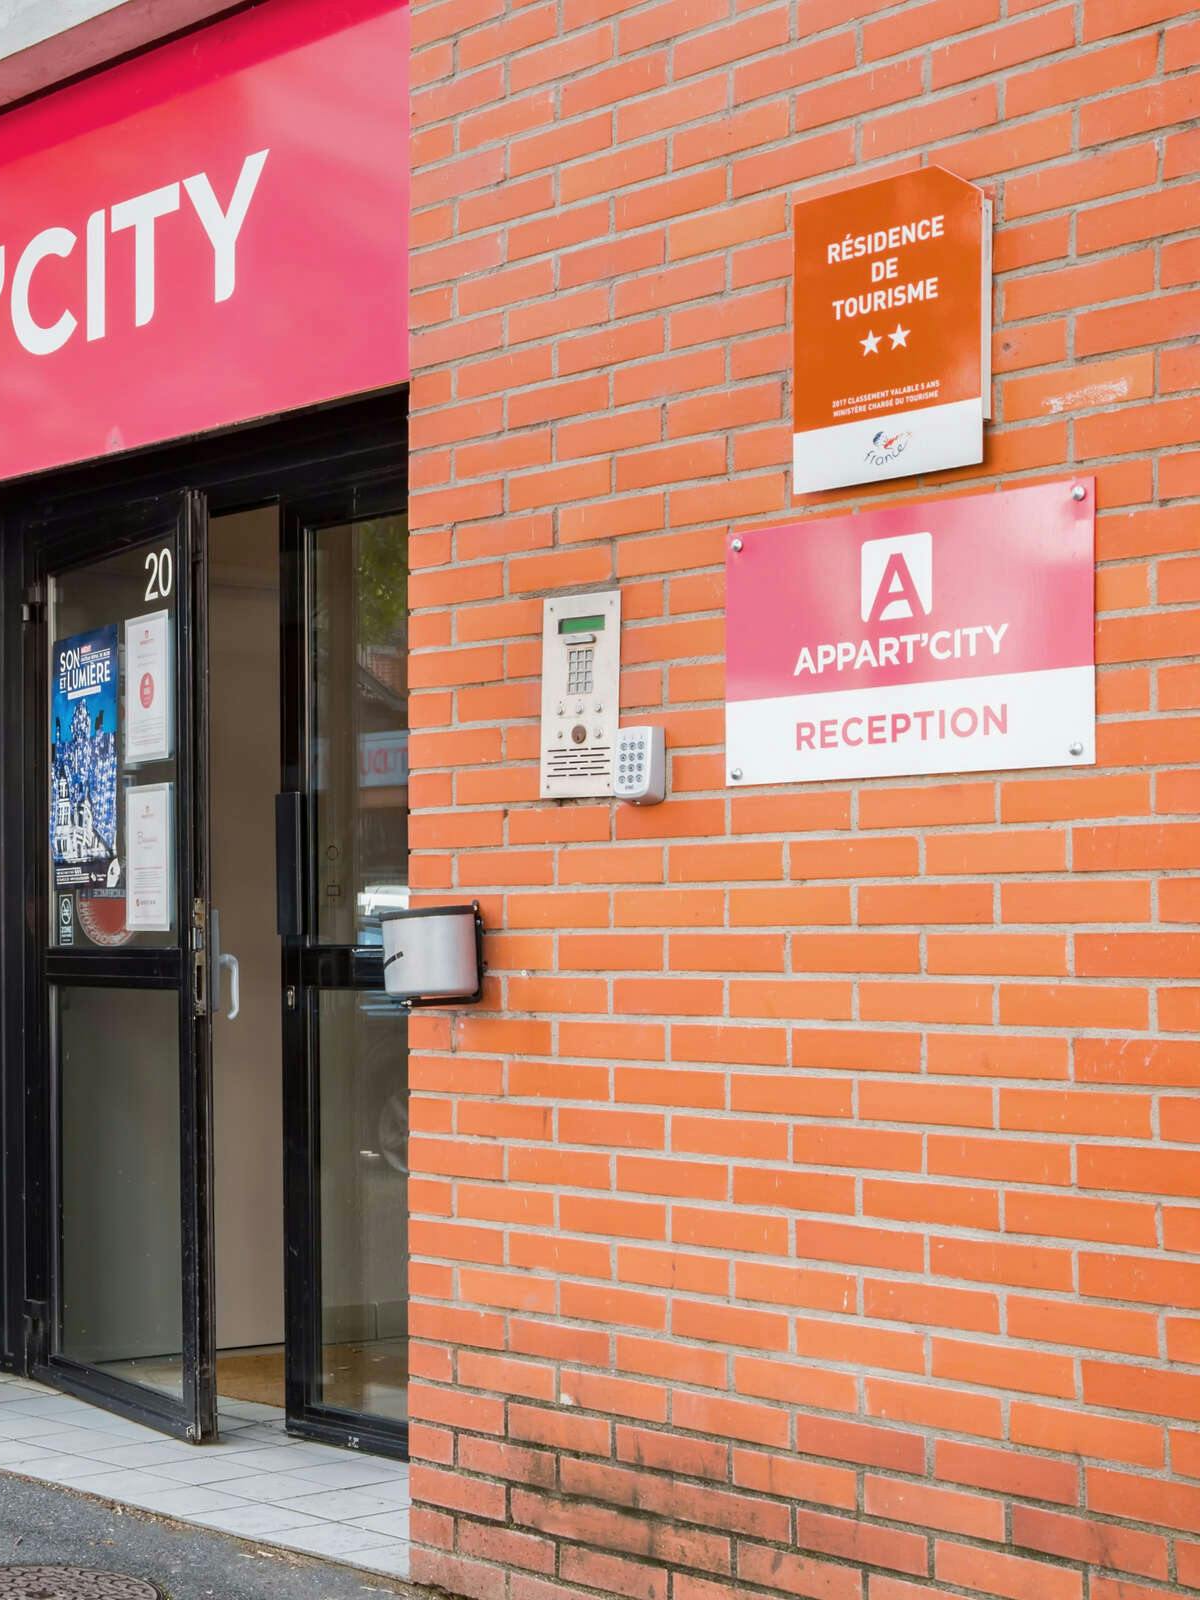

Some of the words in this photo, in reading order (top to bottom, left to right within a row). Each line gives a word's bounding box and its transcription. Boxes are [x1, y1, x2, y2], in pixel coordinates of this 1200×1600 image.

[827, 215, 945, 264] RÉSIDENCE
[870, 257, 898, 283] DE
[832, 277, 939, 320] TOURISME
[847, 390, 889, 405] CLASSEMENT
[890, 383, 919, 396] VALABLE
[926, 379, 940, 389] ANS
[895, 397, 905, 406] DU
[905, 390, 939, 403] TOURISME
[144, 547, 173, 602] 20
[59, 647, 80, 673] SON
[793, 622, 1009, 677] APPART'CITY
[59, 677, 66, 690] ET
[67, 660, 111, 692] LUMIÈRE
[795, 703, 1008, 752] RECEPTION
